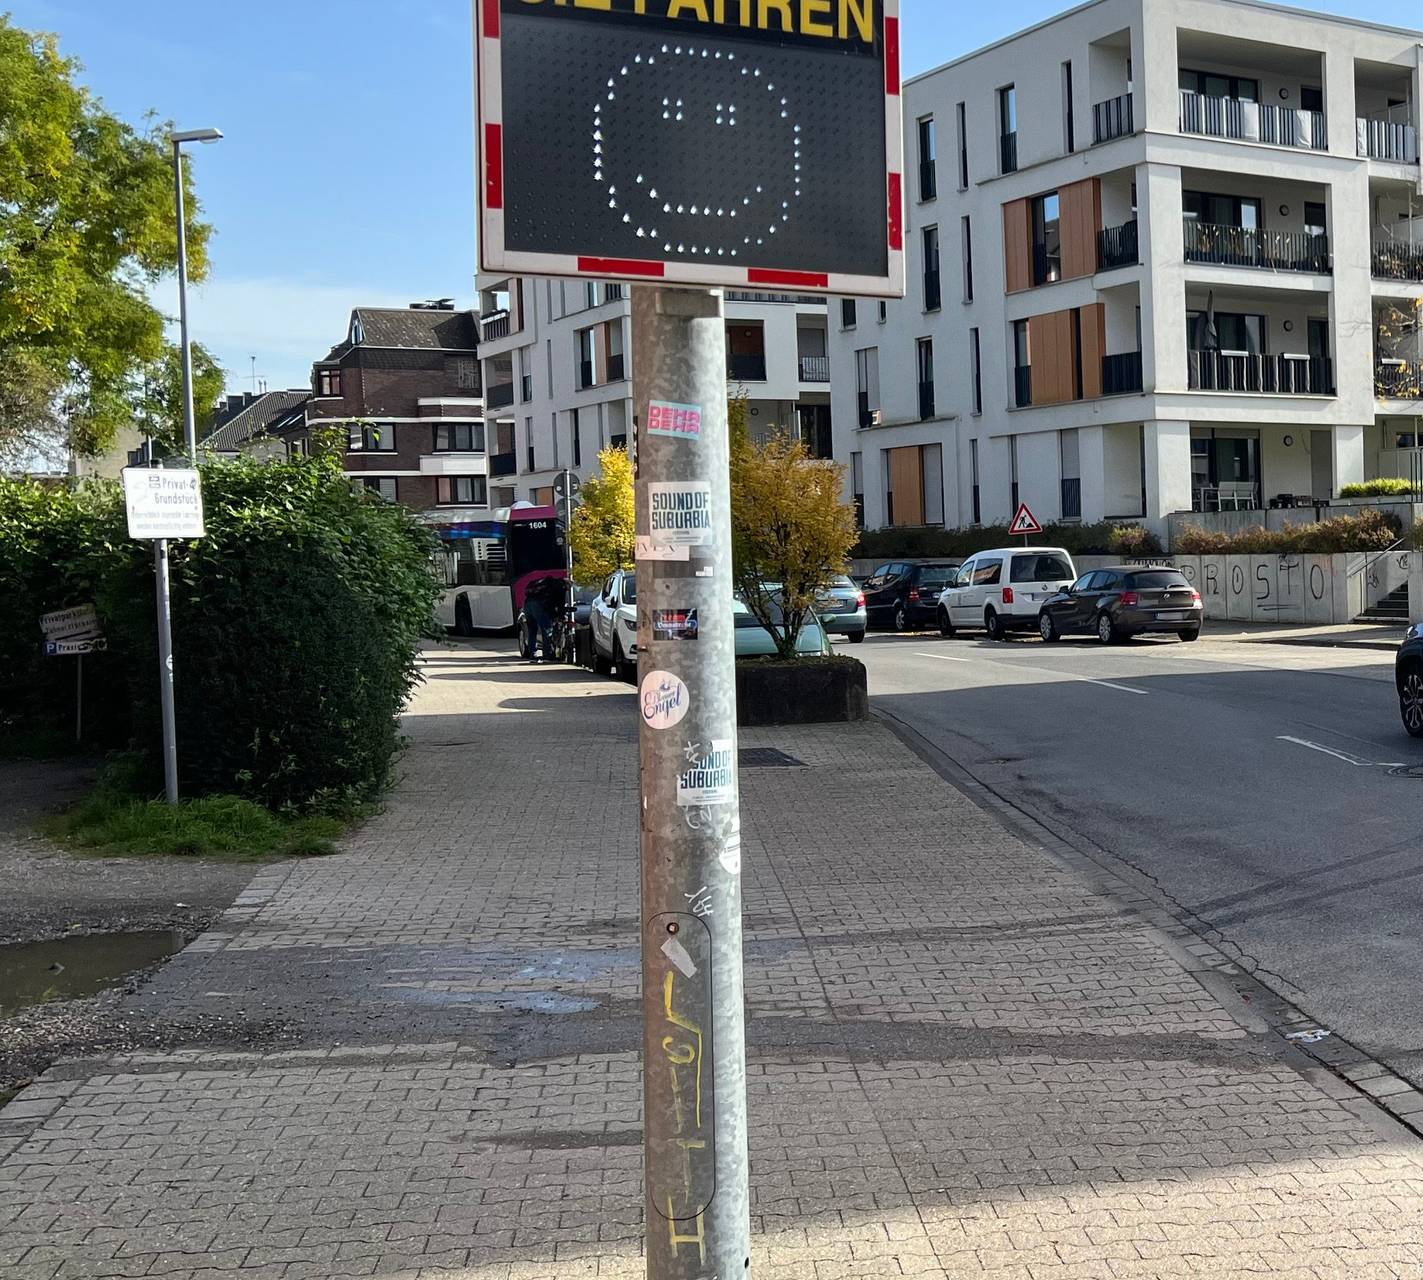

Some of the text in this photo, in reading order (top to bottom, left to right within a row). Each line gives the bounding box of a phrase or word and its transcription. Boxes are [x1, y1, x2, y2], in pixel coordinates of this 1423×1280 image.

[634, 0, 873, 43] REN
[652, 492, 709, 510] SOUND OF
[528, 521, 547, 530] 1604
[652, 510, 710, 529] SUBURBIA
[47, 644, 56, 653] P
